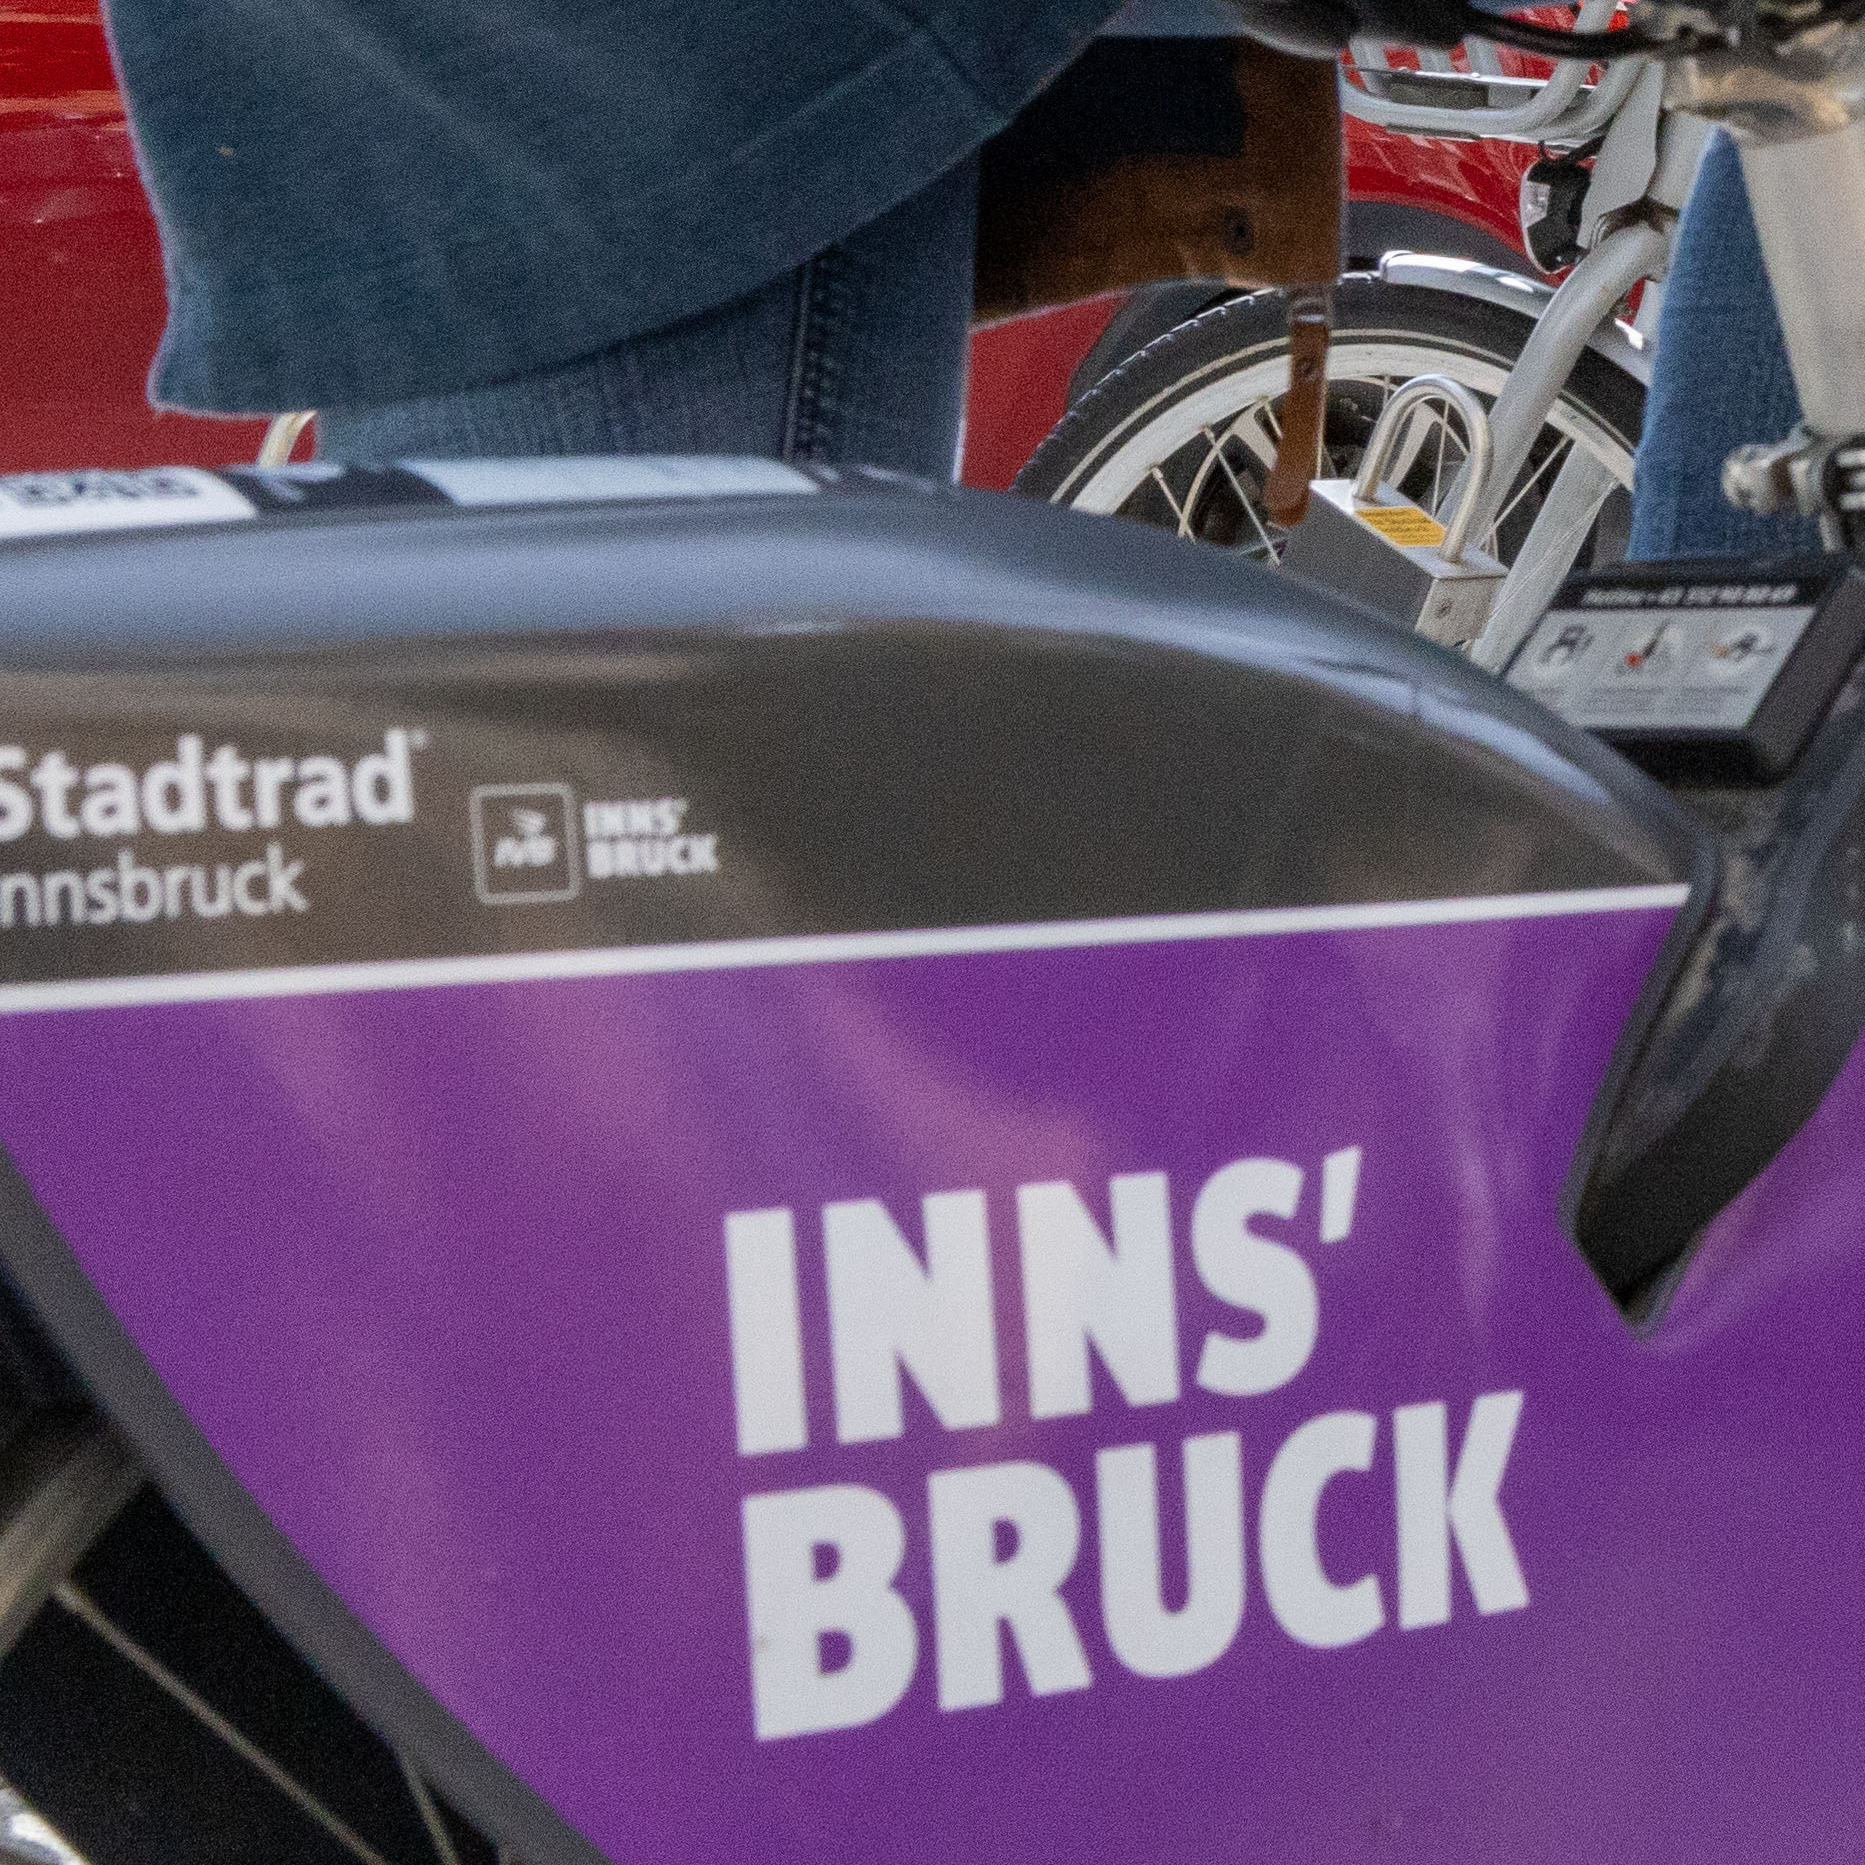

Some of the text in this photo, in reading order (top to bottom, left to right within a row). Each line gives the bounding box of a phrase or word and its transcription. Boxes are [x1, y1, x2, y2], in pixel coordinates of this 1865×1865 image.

[0, 841, 308, 929] nnsbruck
[724, 1144, 1362, 1457] INNS'
[740, 1388, 1531, 1742] BRUCK
